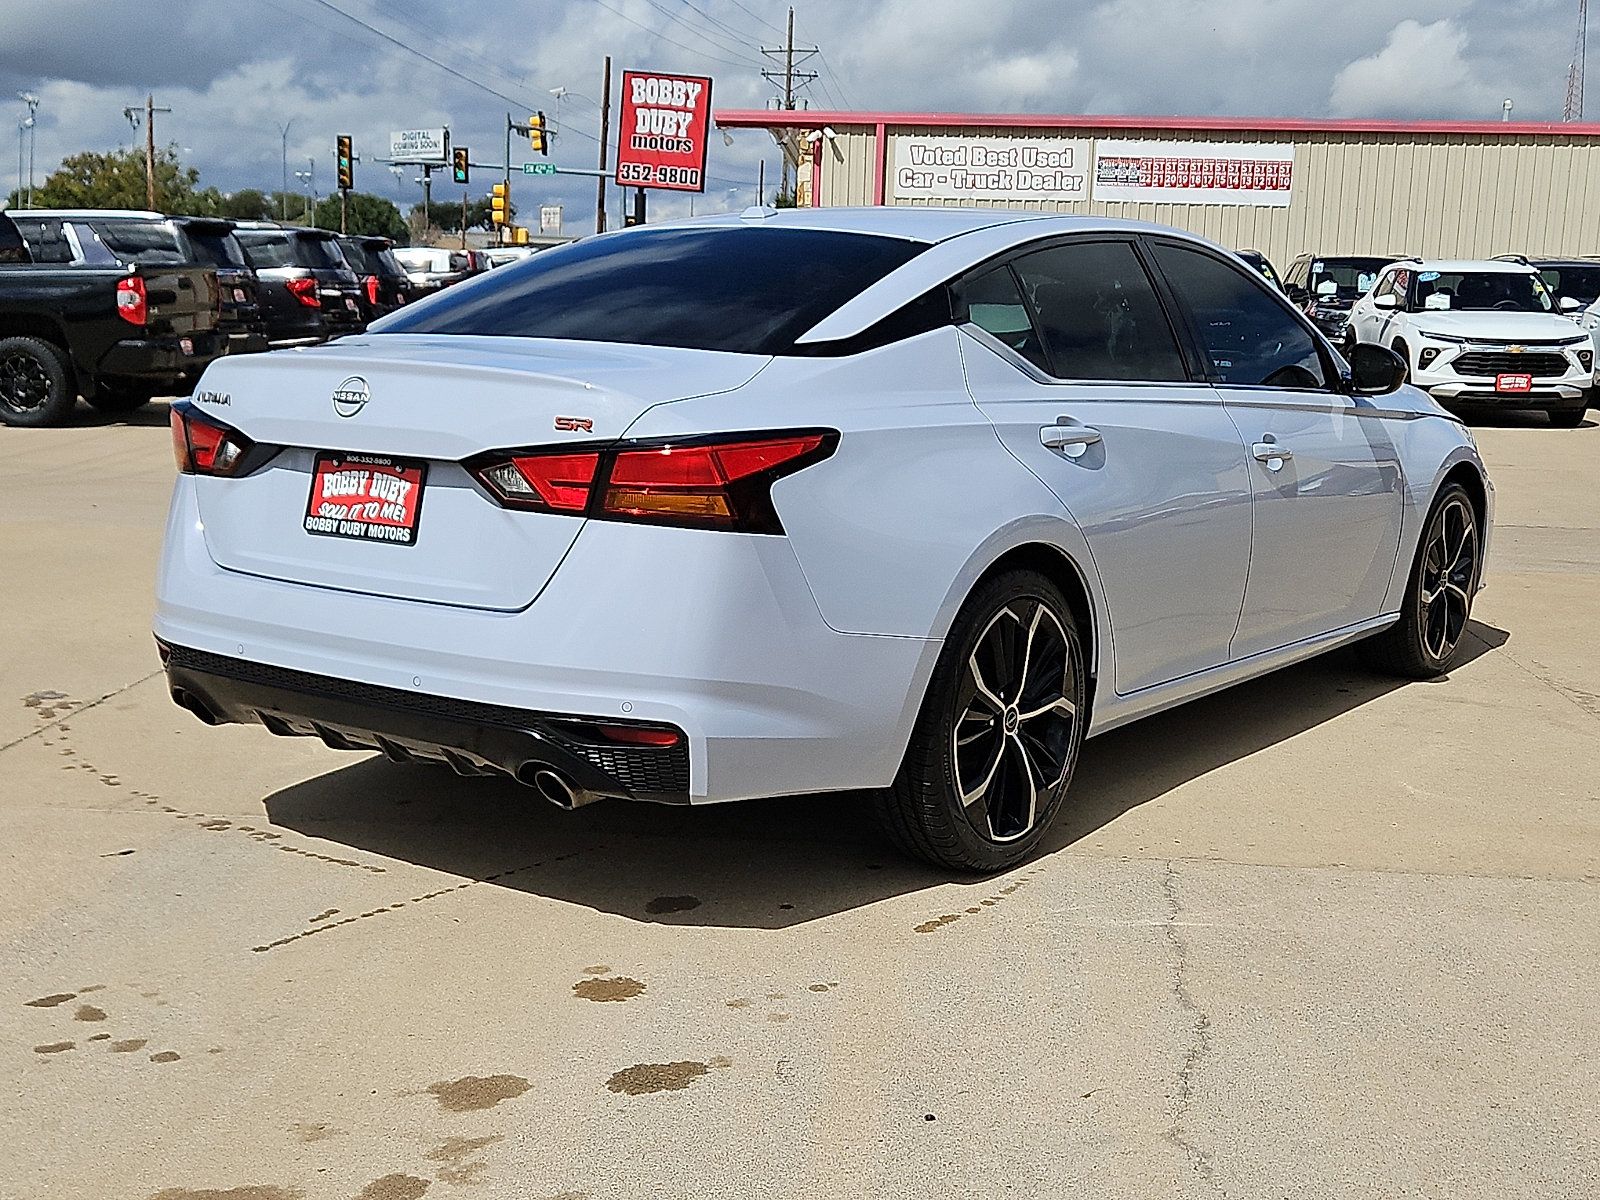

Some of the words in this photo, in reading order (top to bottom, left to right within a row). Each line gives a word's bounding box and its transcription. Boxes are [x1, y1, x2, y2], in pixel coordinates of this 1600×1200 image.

[631, 77, 702, 108] BOBBY
[635, 108, 693, 138] DUBY
[393, 141, 419, 150] COMING
[401, 131, 431, 141] DIGITAL
[632, 135, 692, 152] motors
[910, 145, 967, 166] Voted
[971, 146, 1018, 167] Best
[1022, 146, 1073, 168] Used
[621, 164, 699, 186] 352-9800
[899, 168, 934, 188] Car
[951, 168, 1013, 190] Truck
[1016, 170, 1083, 191] Dealer
[1140, 174, 1151, 183] 22
[1153, 174, 1164, 183] 21
[1165, 174, 1177, 183] 20
[1178, 175, 1188, 184] 19
[1191, 175, 1201, 184] 18
[1203, 175, 1214, 184] 17
[1216, 176, 1226, 184] 15
[1228, 176, 1240, 185] 14
[1241, 176, 1252, 185] 13
[1254, 177, 1265, 185] 12
[1266, 177, 1277, 186] 11
[1279, 177, 1290, 186] 10
[333, 391, 369, 402] NISSAN
[554, 416, 593, 433] SR
[322, 470, 370, 498] BOBBY
[369, 472, 412, 505] DUBY
[318, 501, 348, 519] SOLD
[347, 503, 364, 520] IT
[362, 501, 380, 519] TO
[380, 502, 406, 523] ME!
[306, 516, 339, 533] BOBBY
[339, 520, 368, 536] DUBY
[367, 523, 411, 542] MOTORS
